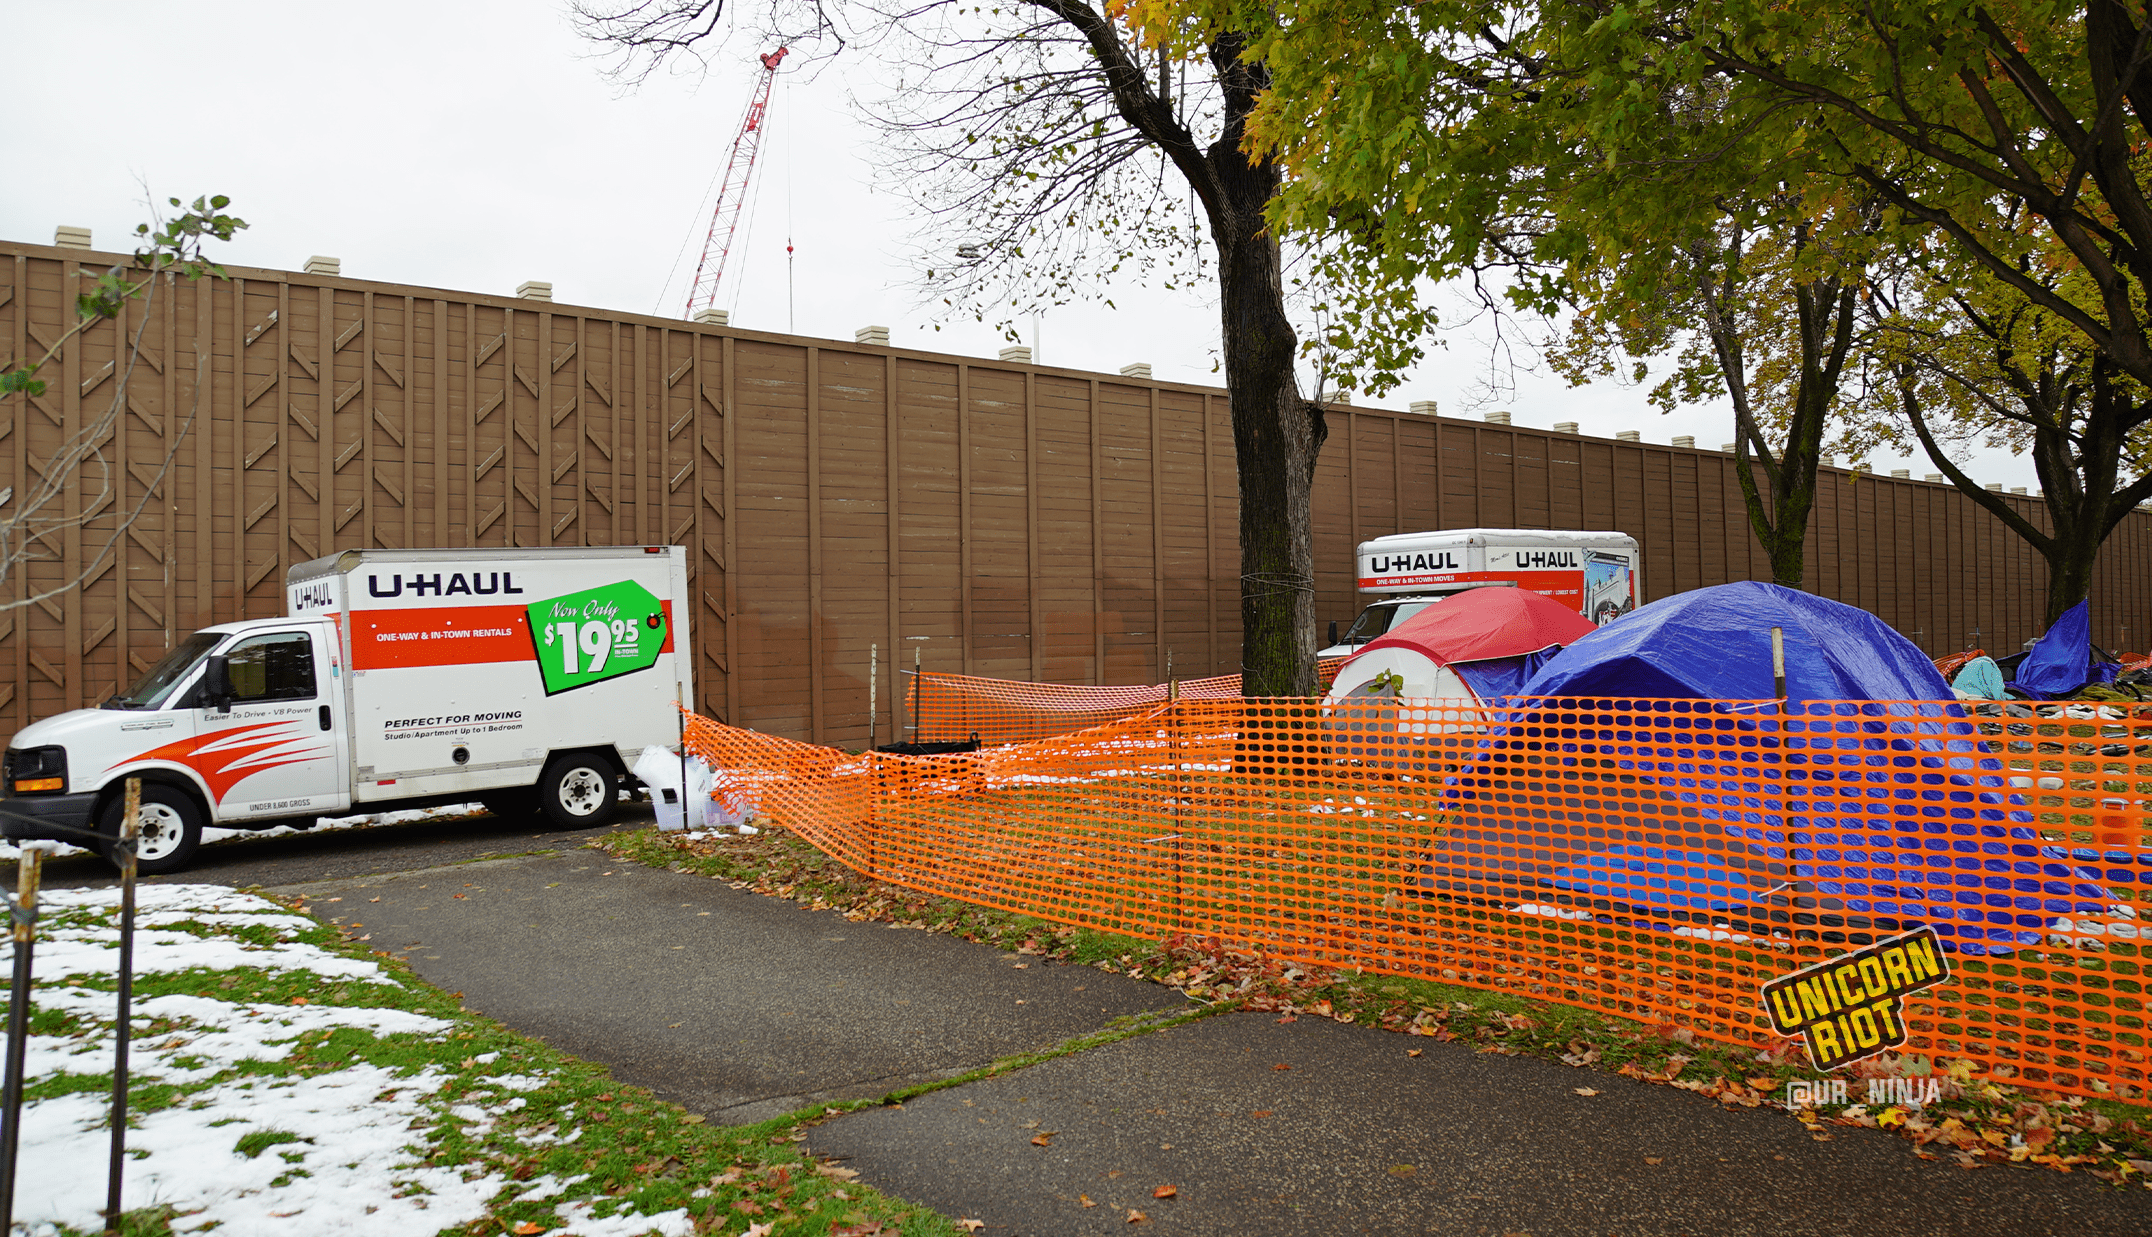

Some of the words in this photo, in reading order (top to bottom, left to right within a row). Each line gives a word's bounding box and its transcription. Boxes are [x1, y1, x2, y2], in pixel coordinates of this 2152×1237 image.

[1372, 552, 1458, 573] U-HAUL
[1516, 552, 1578, 568] U-HAUL
[368, 572, 523, 598] U-HAUL
[295, 582, 333, 610] U-HAUL
[549, 601, 580, 618] Now
[583, 600, 619, 621] Only
[376, 632, 419, 642] ONE-WAY
[420, 631, 429, 640] &
[430, 629, 471, 640] IN-TOWN
[472, 628, 512, 638] RENTALS
[204, 713, 230, 721] Easier
[286, 707, 312, 715] Power
[384, 716, 443, 729] PERFECT
[445, 714, 471, 724] FOR
[474, 710, 522, 722] MOVING
[384, 729, 458, 741] Studio/Apartment
[460, 728, 471, 736] Up
[488, 723, 523, 732] Bedroom
[249, 802, 272, 811] UNDER
[289, 798, 310, 808] GROSS
